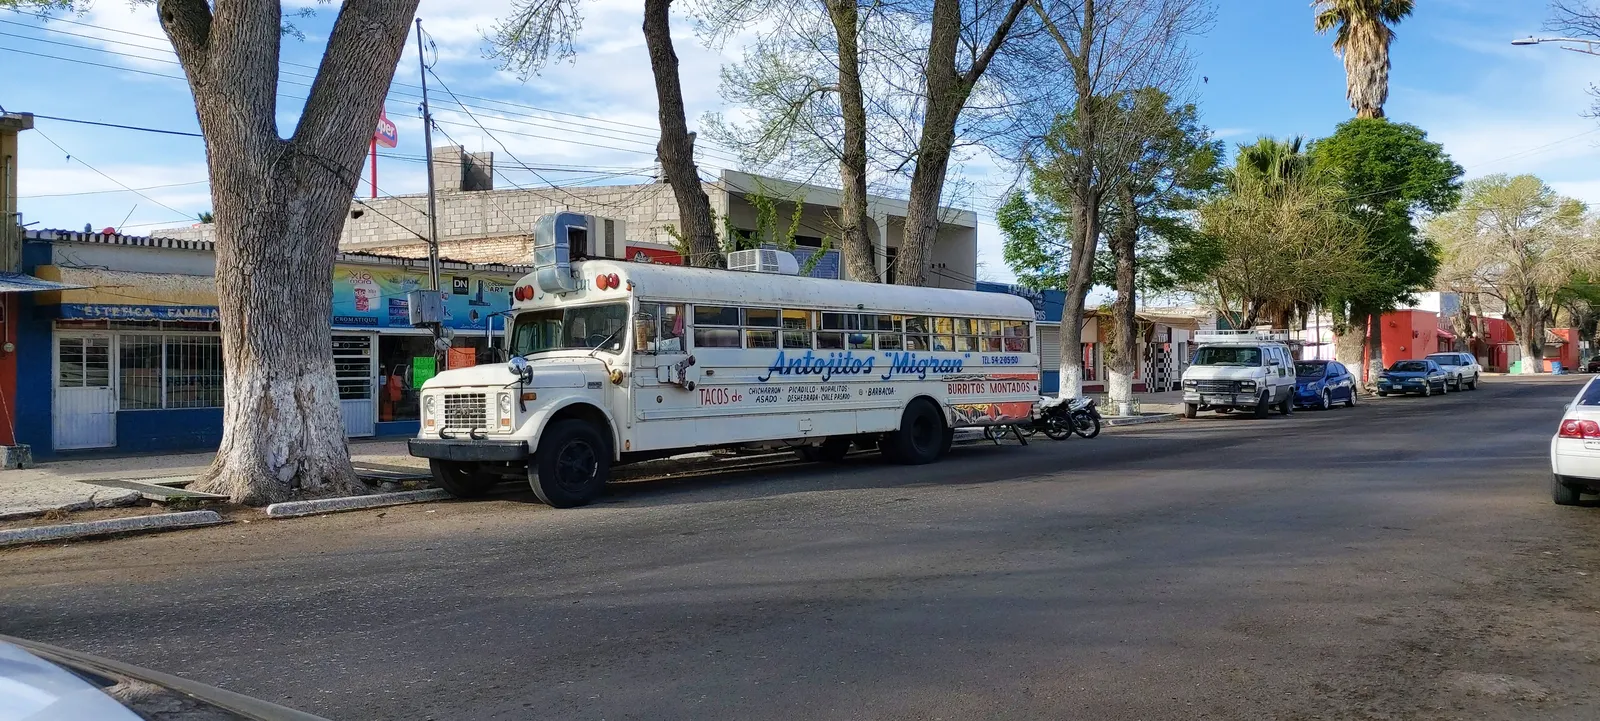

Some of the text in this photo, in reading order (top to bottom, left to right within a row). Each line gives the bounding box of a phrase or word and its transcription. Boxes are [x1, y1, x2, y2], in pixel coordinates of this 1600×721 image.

[454, 279, 468, 288] DN
[758, 351, 875, 382] Antojitos
[788, 386, 816, 394] PICADILLO
[820, 385, 848, 393] NOPALITOS
[867, 387, 895, 397] BARBACOA
[948, 382, 1031, 395] BURRITOS MONTADOS
[699, 388, 743, 406] TACOS de
[755, 395, 778, 404] ASADO
